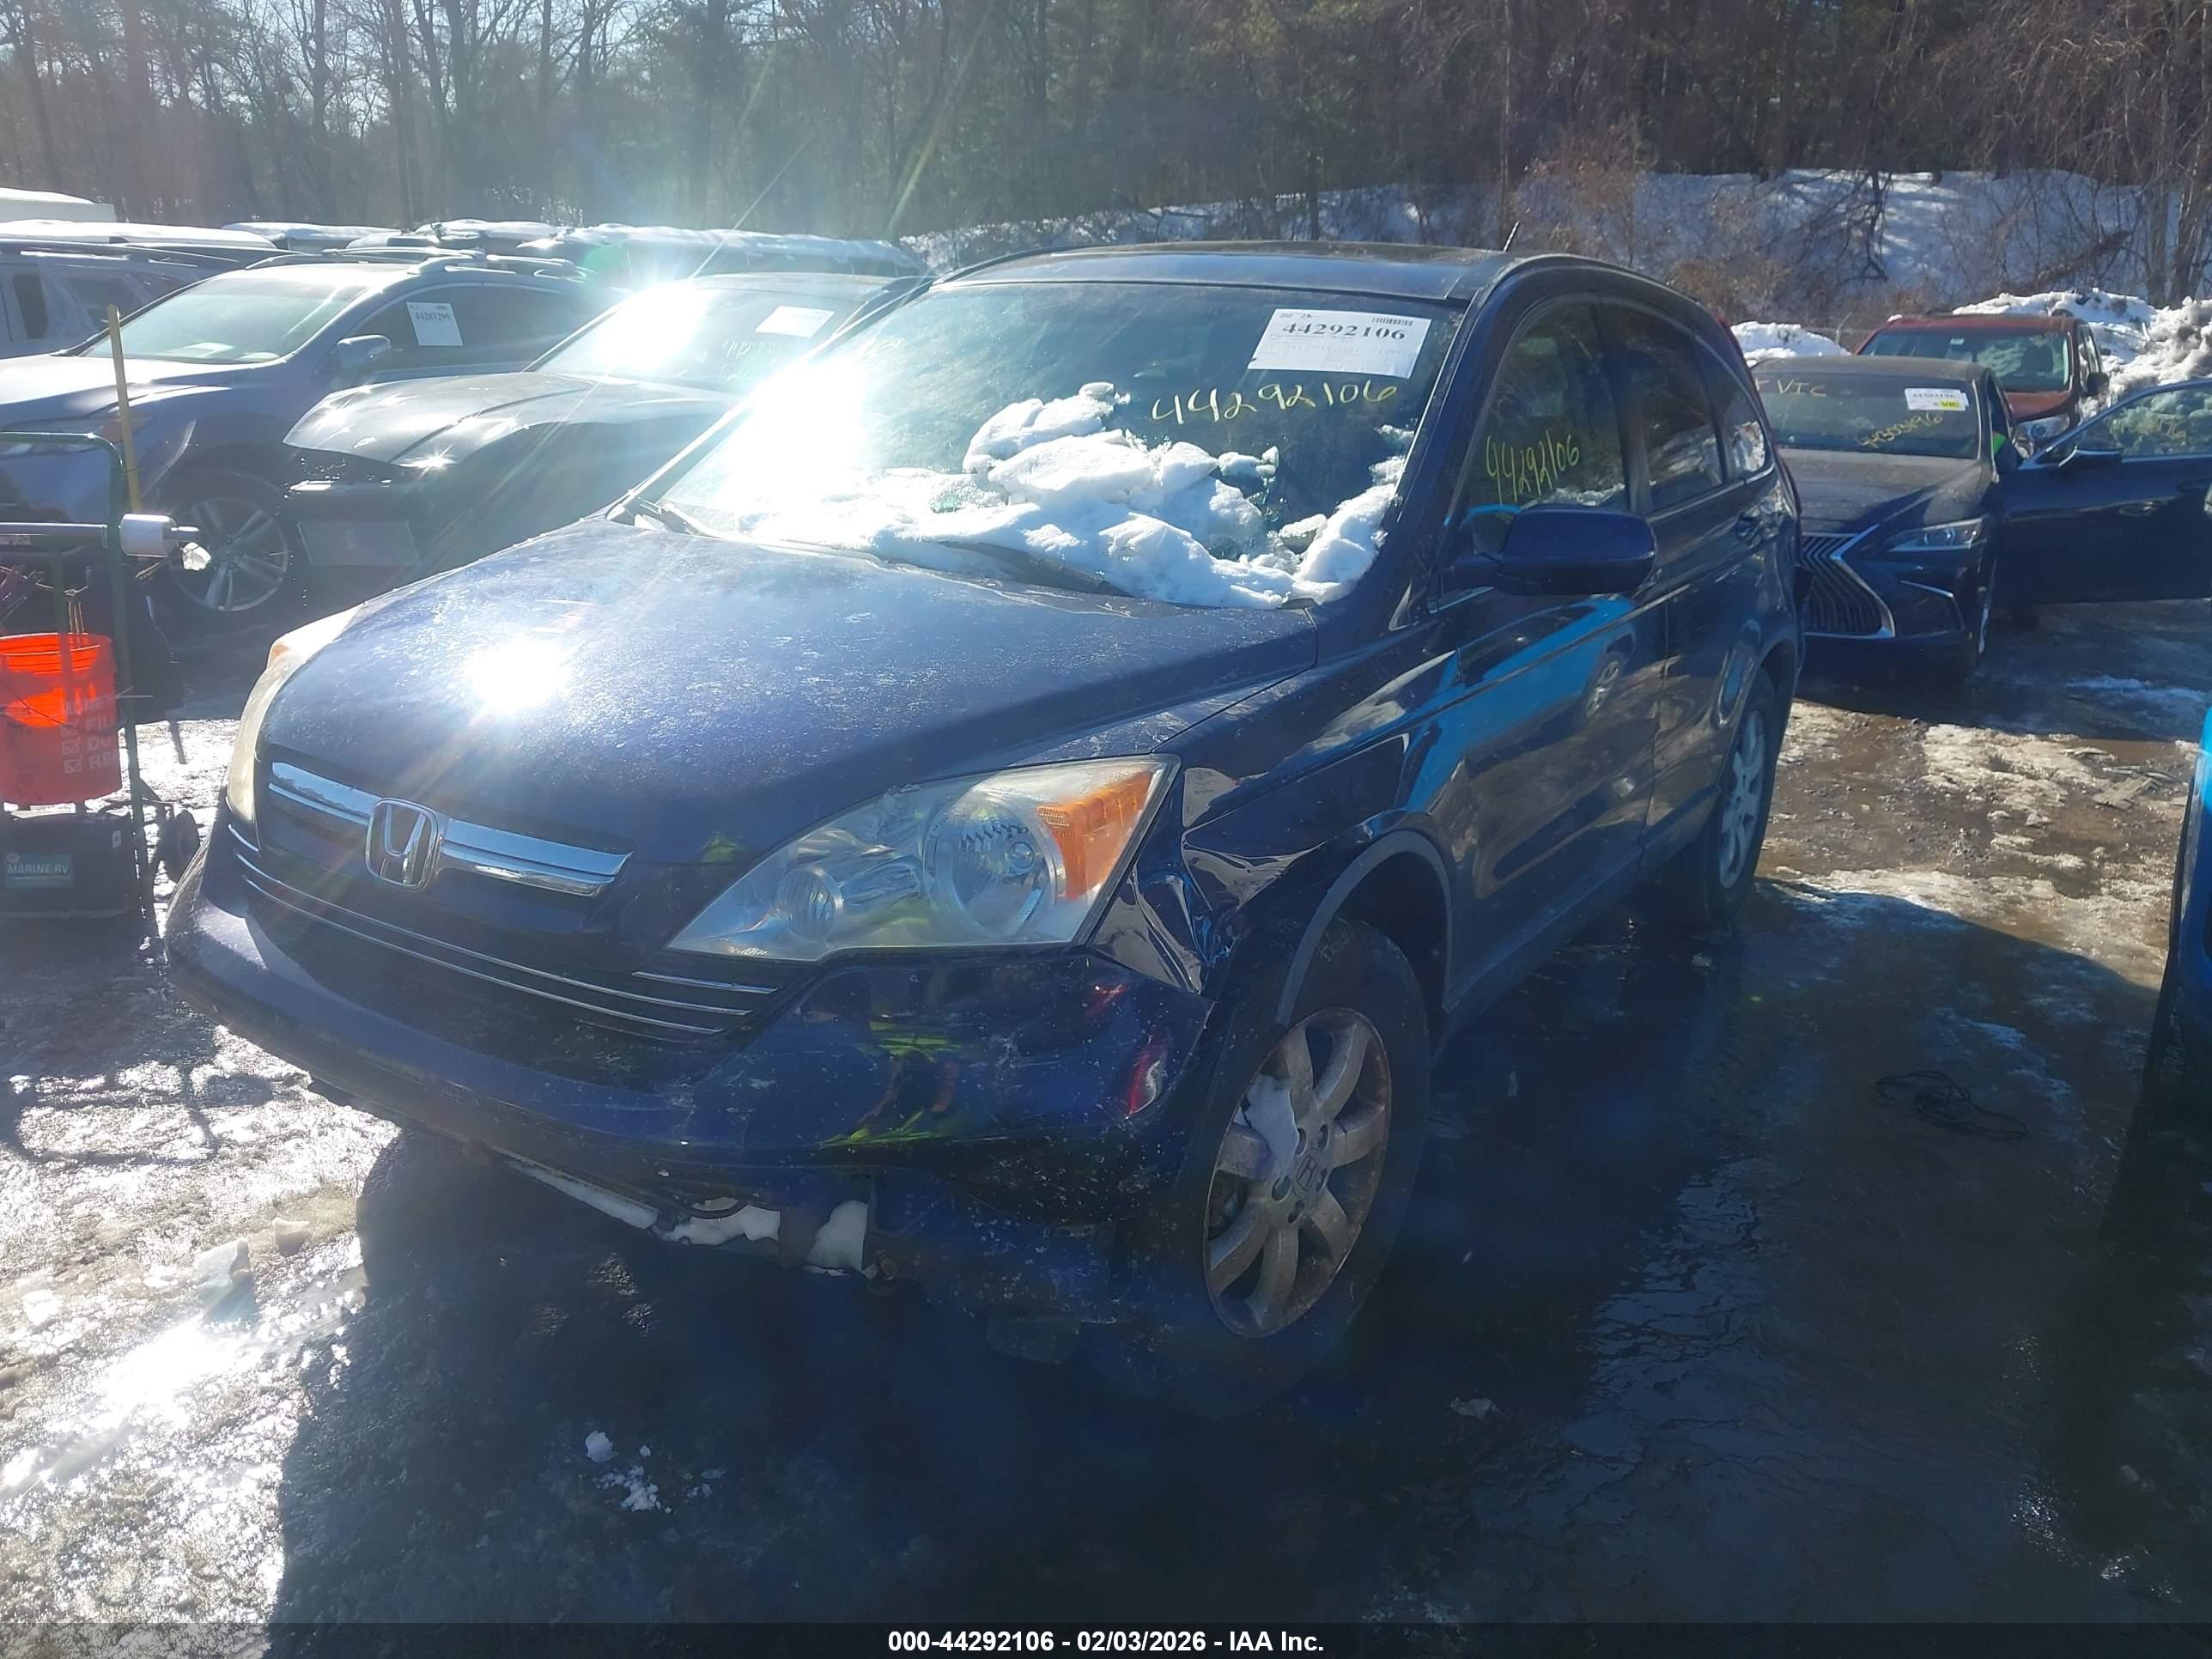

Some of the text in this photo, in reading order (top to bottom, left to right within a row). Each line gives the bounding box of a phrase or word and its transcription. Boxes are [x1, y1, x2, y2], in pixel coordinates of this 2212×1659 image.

[1282, 323, 1406, 340] 44292106
[1777, 378, 1827, 397] VIC
[1152, 380, 1398, 425] 44292106
[1486, 429, 1580, 506] 44292106
[7, 864, 52, 873] MARINE
